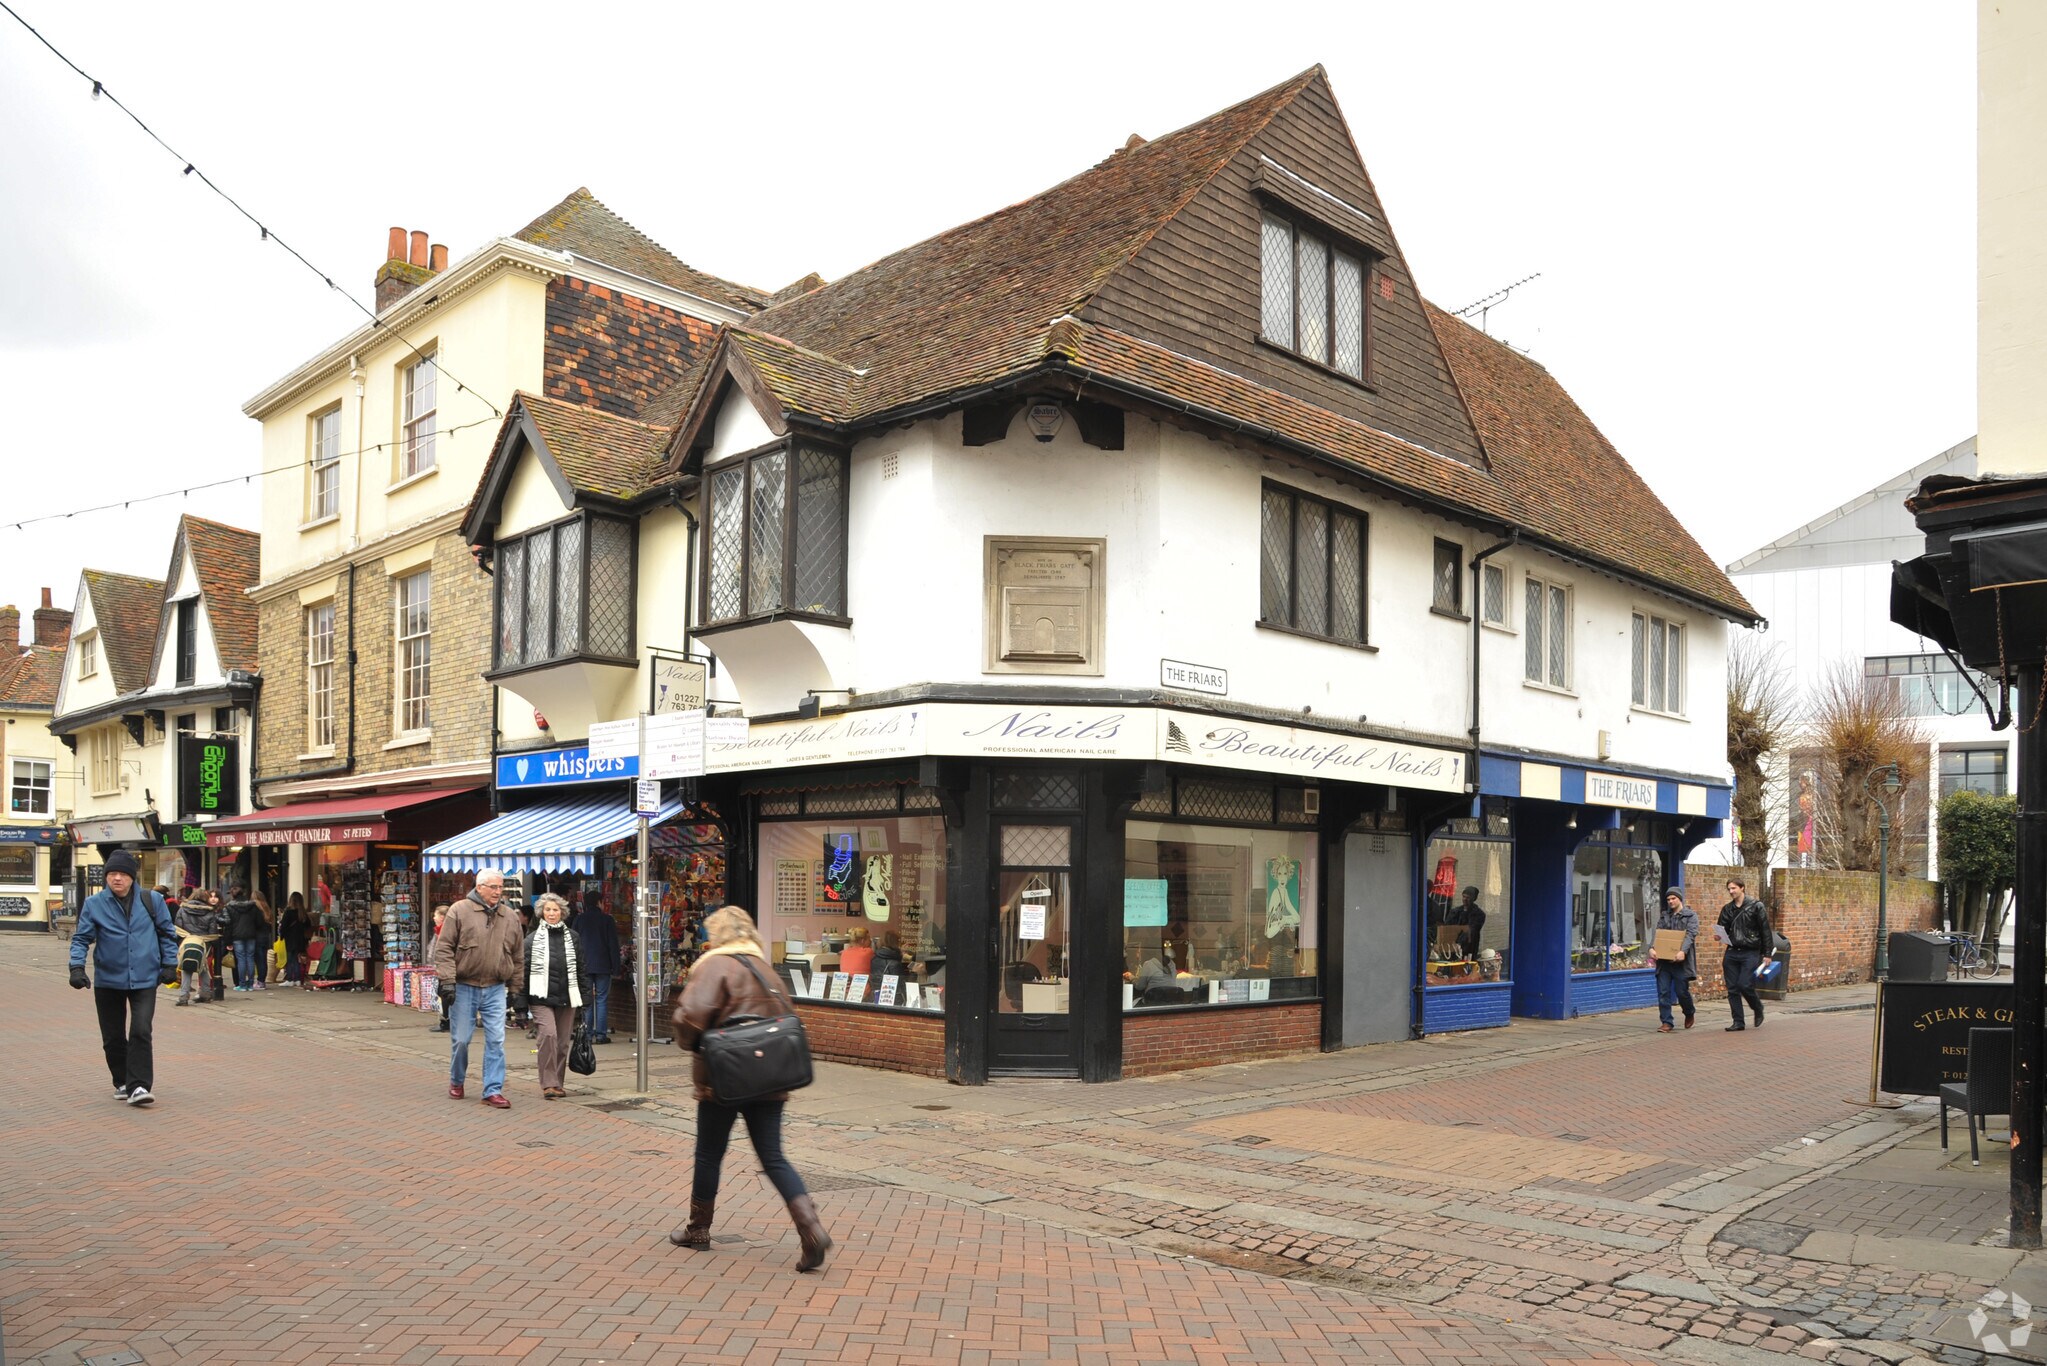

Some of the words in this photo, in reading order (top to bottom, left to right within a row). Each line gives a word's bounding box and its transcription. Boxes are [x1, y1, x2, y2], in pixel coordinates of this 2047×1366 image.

[1033, 406, 1058, 416] Sabre
[655, 665, 704, 682] Nails
[1166, 667, 1186, 682] THE
[1188, 671, 1223, 688] FRIARS
[671, 702, 686, 711] 763
[674, 693, 700, 703] 01227
[829, 714, 902, 740] Nails
[962, 711, 1126, 739] Nails
[543, 752, 626, 778] whispers
[1199, 727, 1378, 770] Beautiful
[1370, 751, 1443, 777] Nails
[203, 745, 221, 809] Emporium
[1591, 777, 1613, 798] THE
[1615, 781, 1652, 805] FRIARS
[215, 836, 220, 845] ST
[245, 832, 258, 845] THE
[258, 830, 293, 844] MERCHANT
[294, 828, 331, 843] CHANDLER
[343, 829, 350, 839] ST
[351, 827, 373, 838] PETERS
[1913, 1006, 1971, 1032] STEAK
[1974, 1007, 1987, 1020] &
